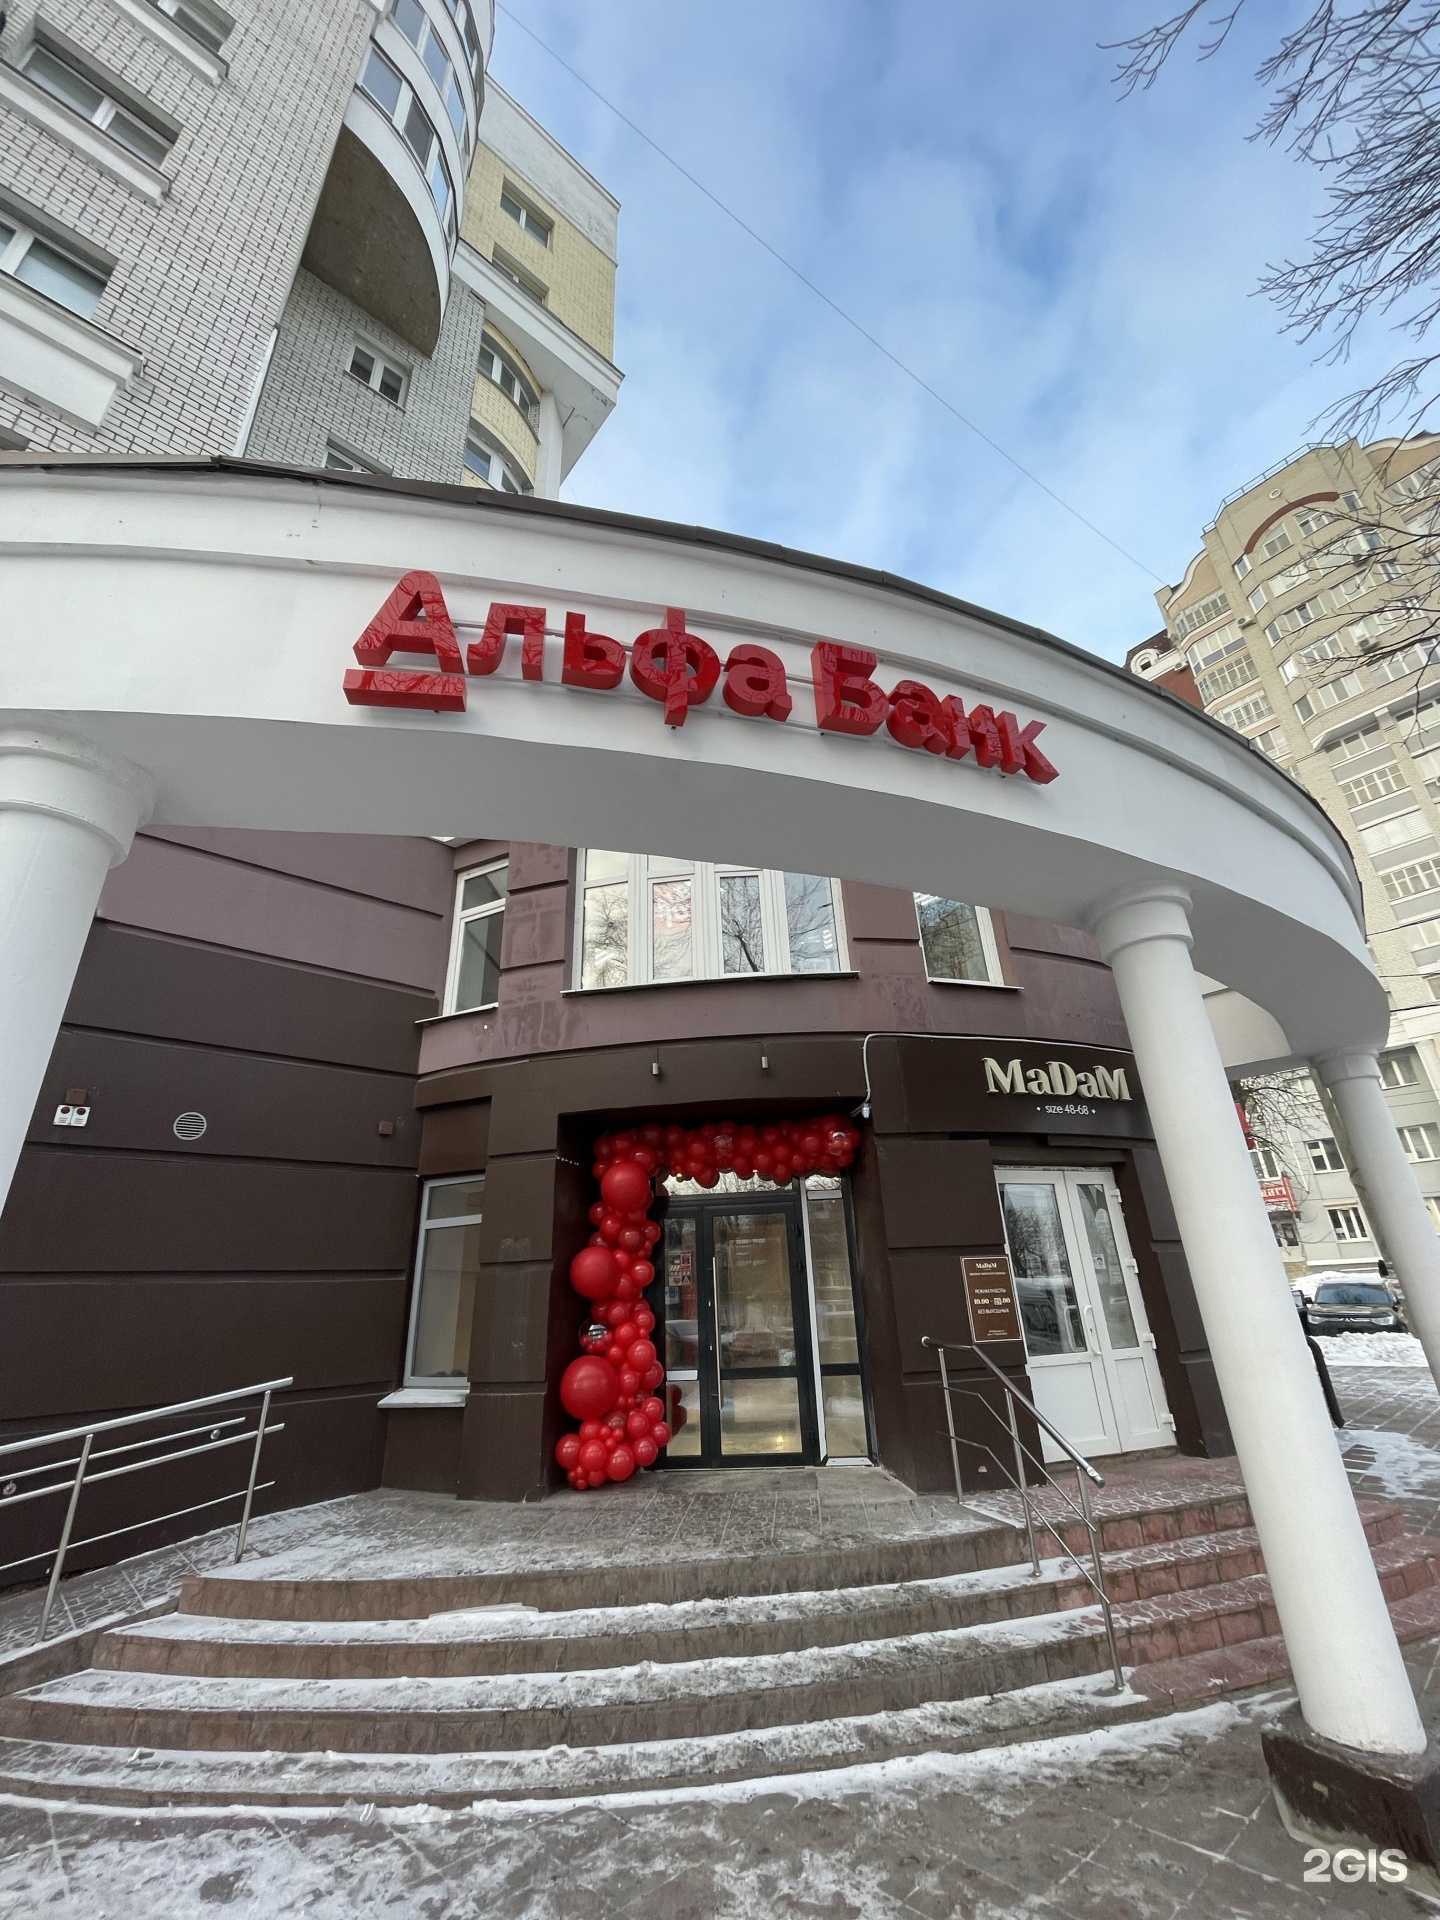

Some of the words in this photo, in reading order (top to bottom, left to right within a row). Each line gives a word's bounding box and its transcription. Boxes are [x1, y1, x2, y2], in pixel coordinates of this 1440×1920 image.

[343, 571, 793, 728] Альфа
[811, 641, 1060, 785] Банк
[981, 1057, 1133, 1101] MaDaM
[1045, 1105, 1063, 1114] size
[1064, 1104, 1089, 1115] 48-68
